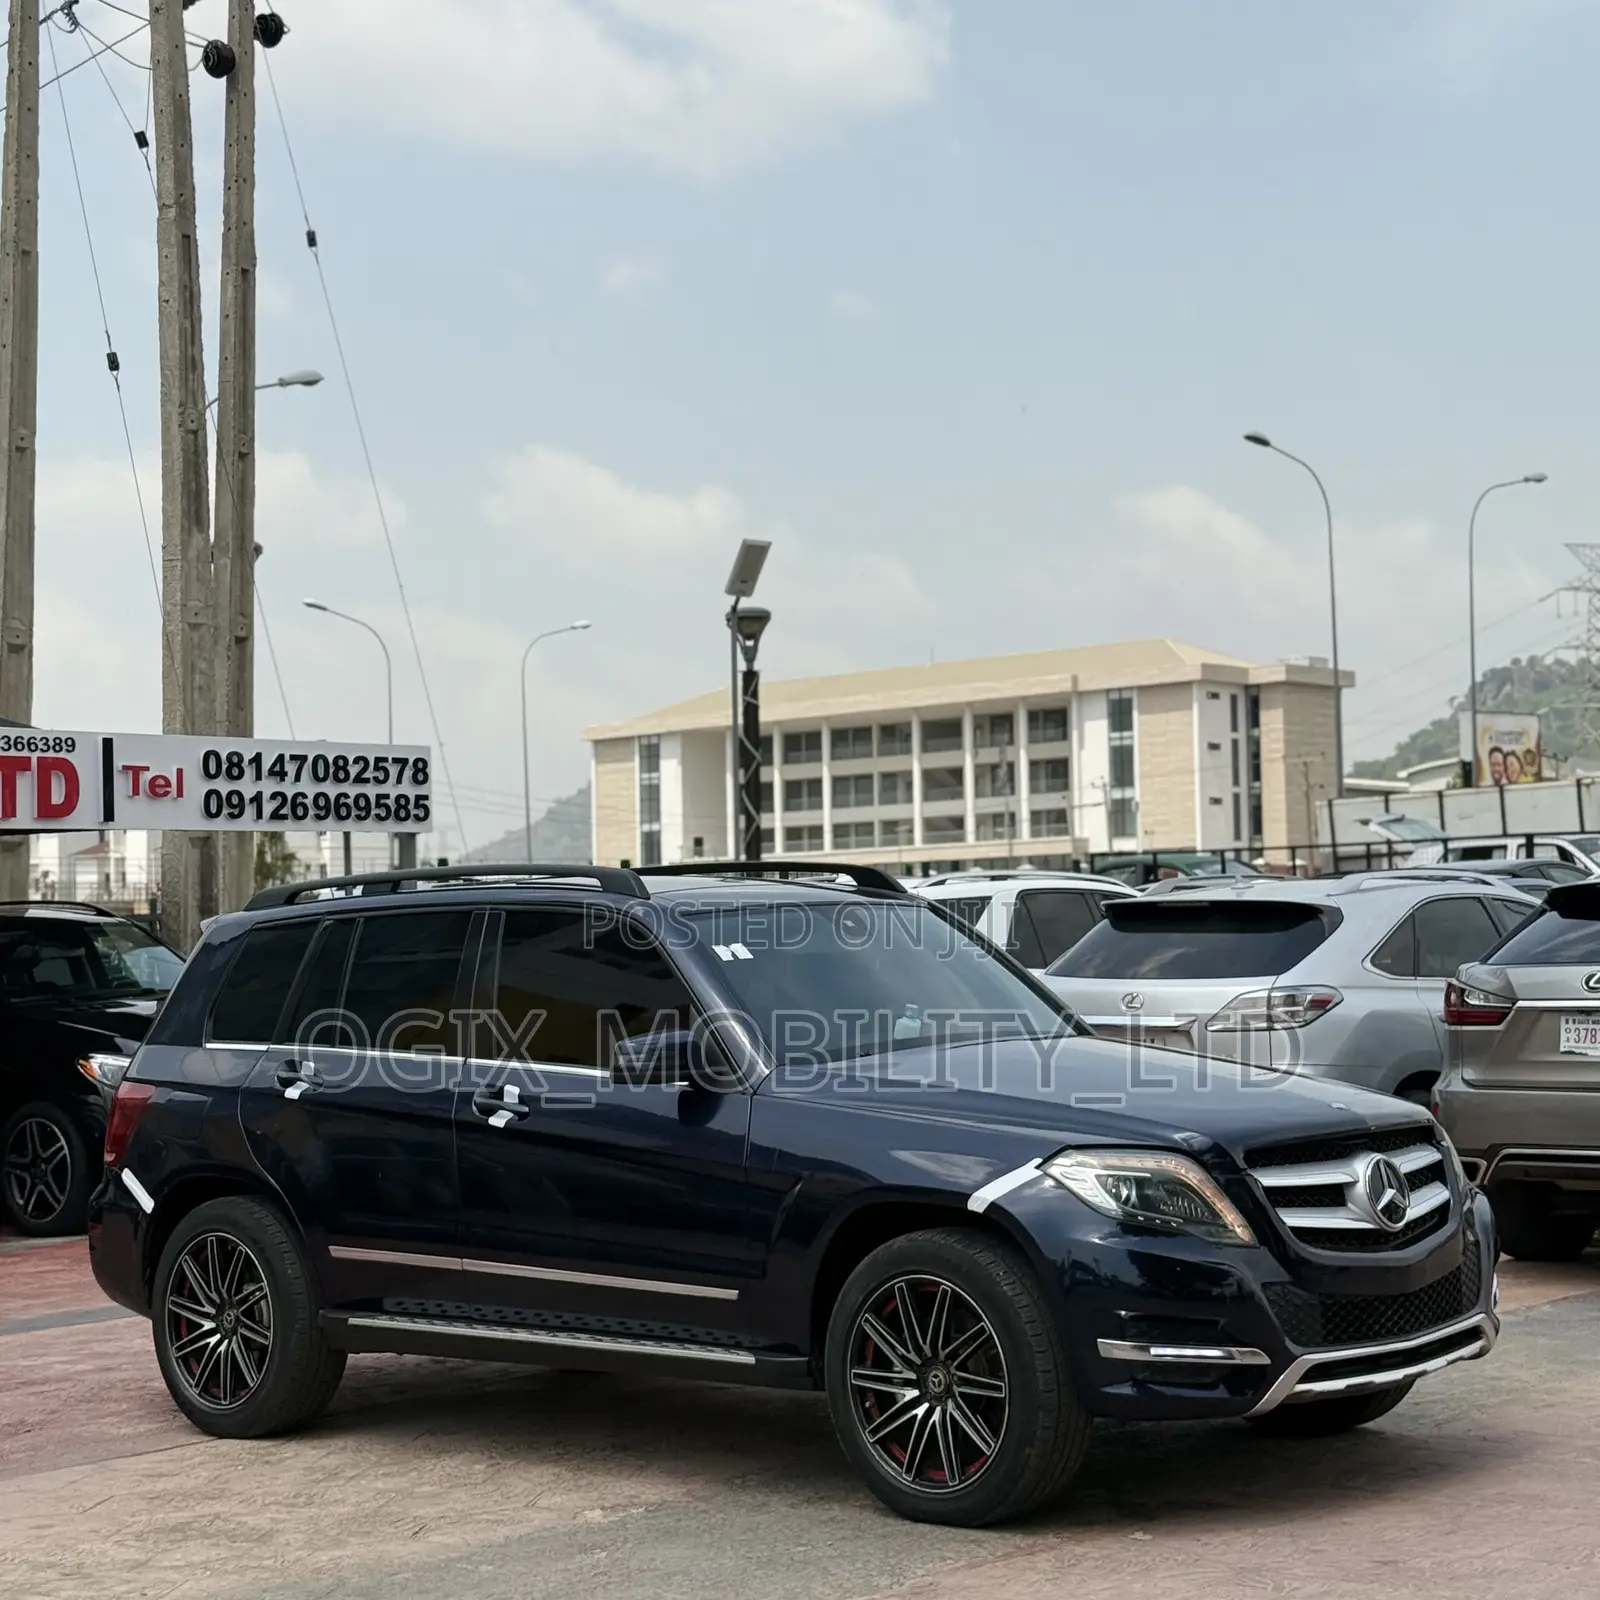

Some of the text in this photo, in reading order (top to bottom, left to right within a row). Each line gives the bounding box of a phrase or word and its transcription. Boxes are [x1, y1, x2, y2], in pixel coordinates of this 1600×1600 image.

[0, 735, 76, 753] 366389
[122, 764, 184, 798] Tel
[202, 749, 430, 786] 08147082578
[0, 756, 80, 819] TD
[203, 788, 430, 822] 09126969585
[1573, 1027, 1600, 1044] 378
